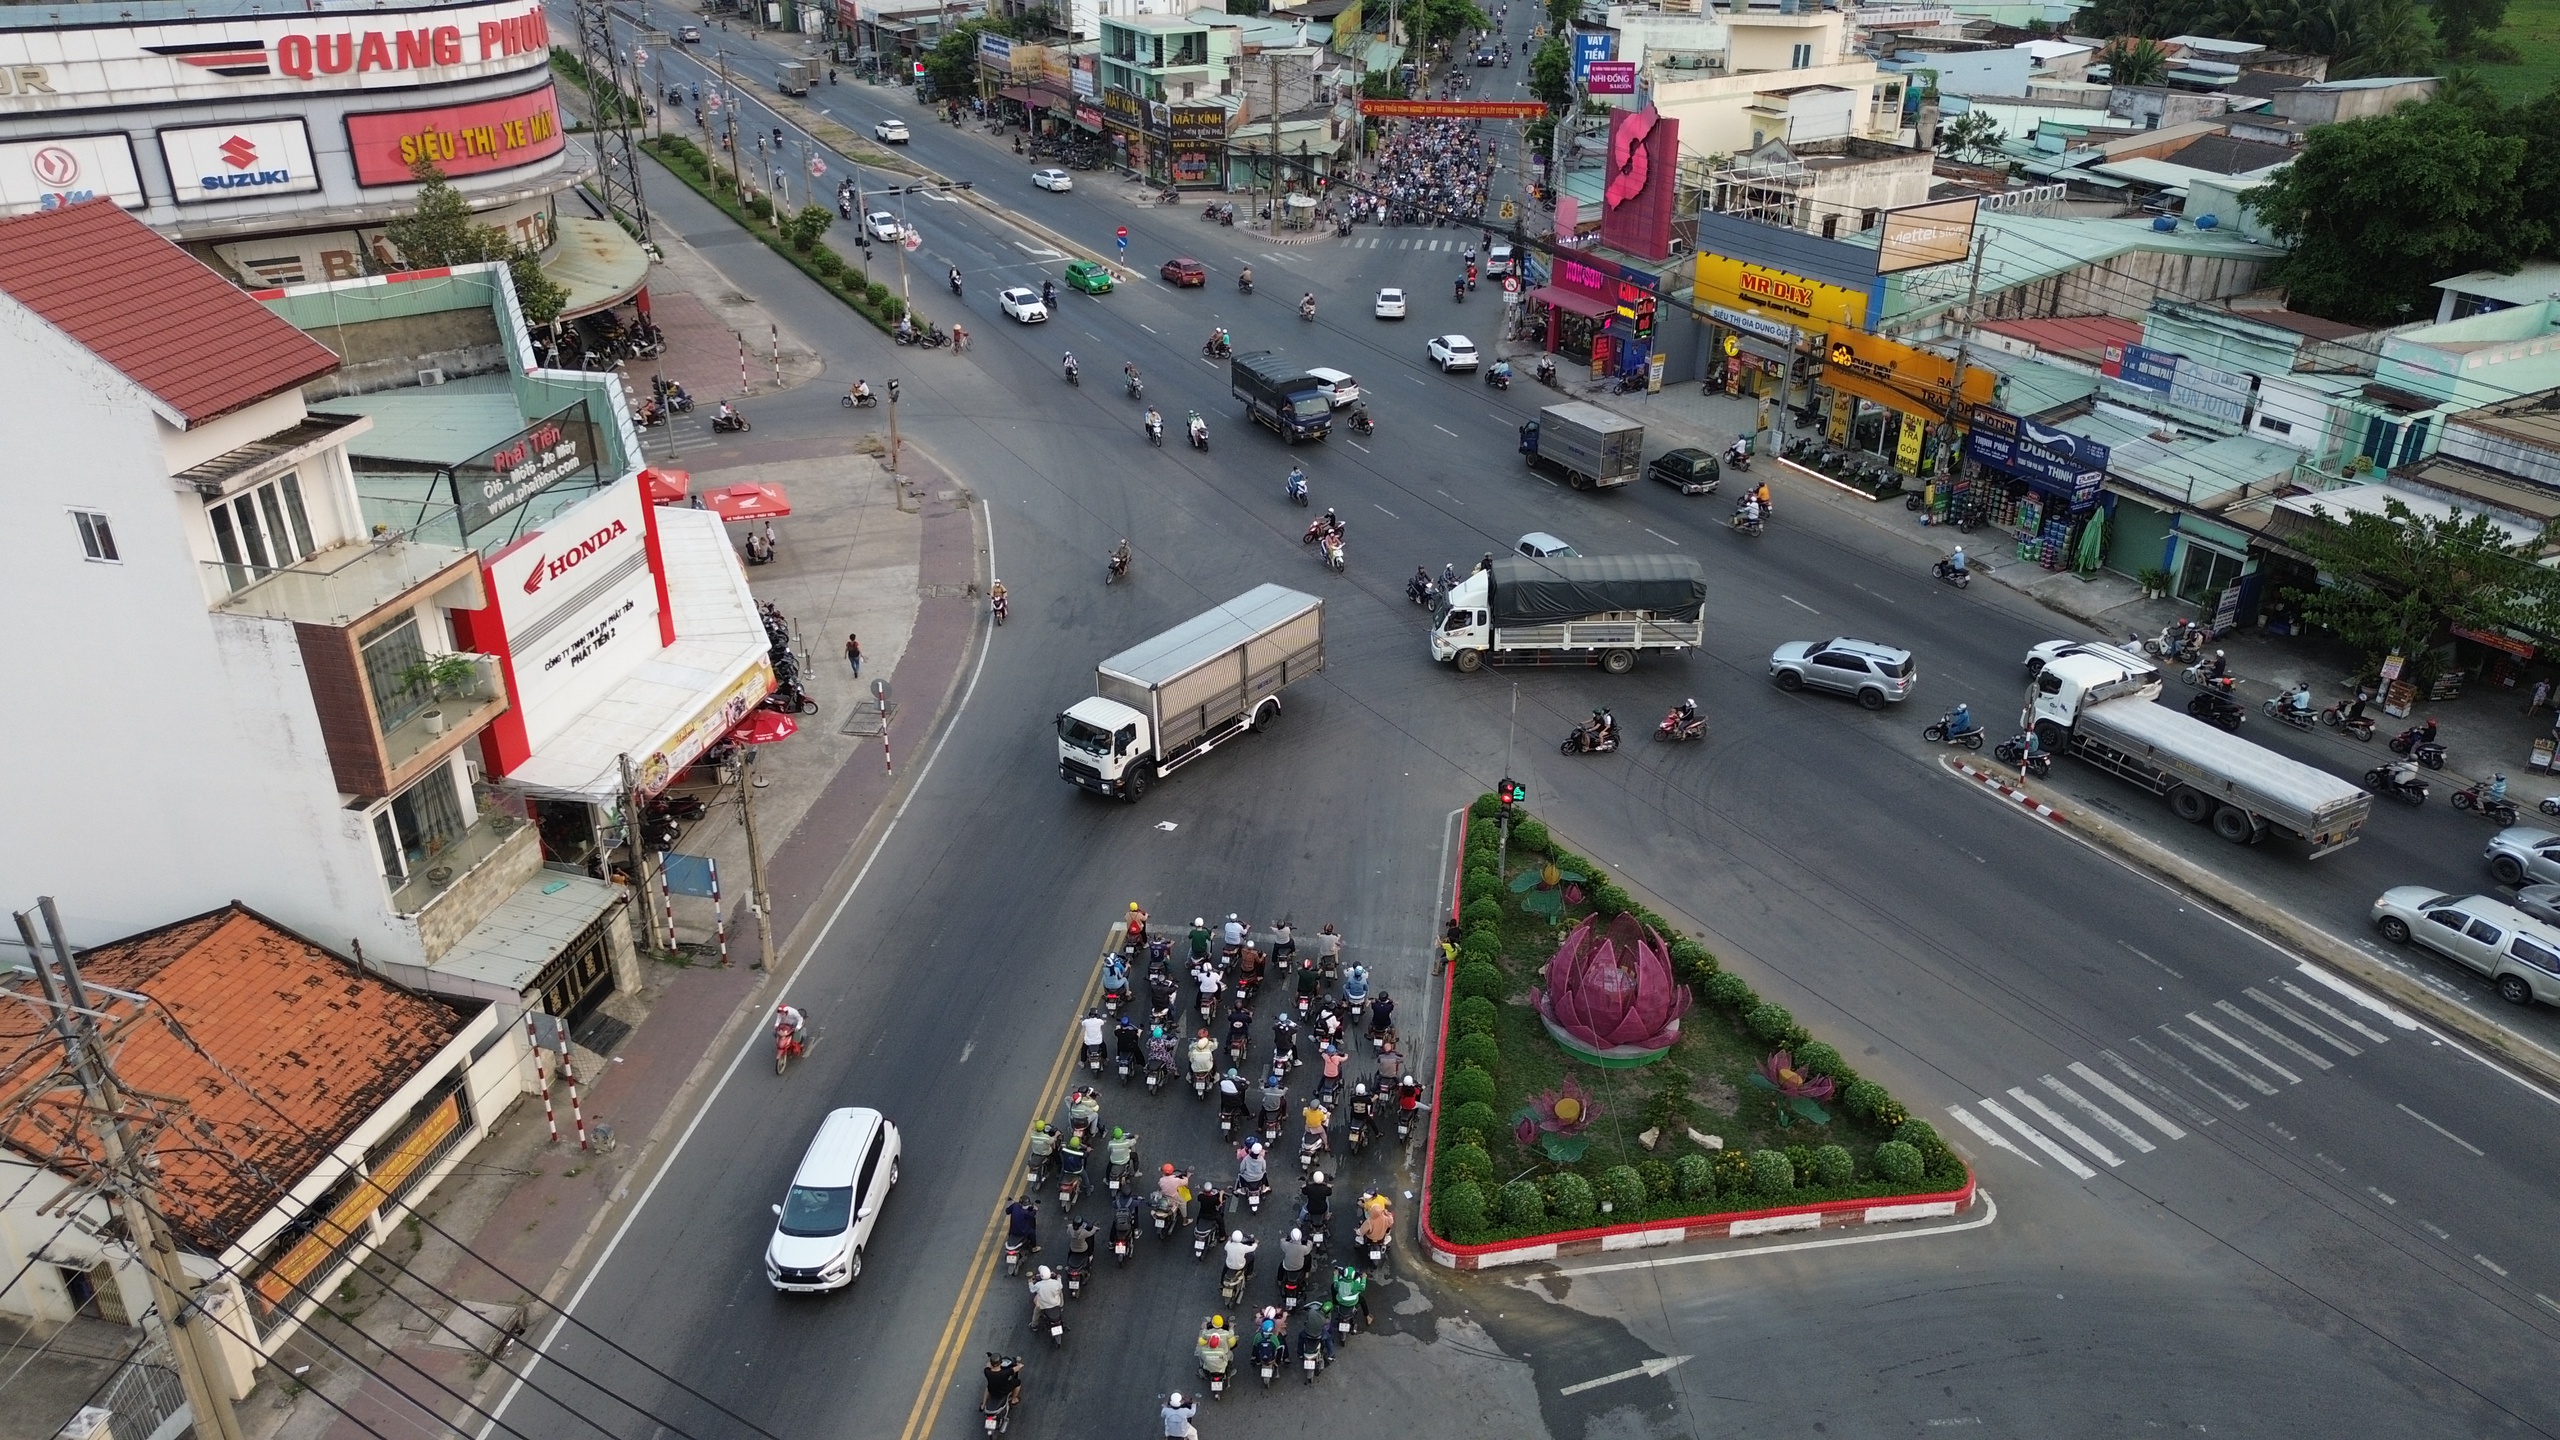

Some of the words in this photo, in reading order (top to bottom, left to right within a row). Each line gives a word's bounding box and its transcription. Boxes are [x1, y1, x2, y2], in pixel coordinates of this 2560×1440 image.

[1587, 36, 1604, 45] VAY
[278, 26, 462, 80] QUANG
[1591, 75, 1606, 83] NHI
[1173, 109, 1195, 124] MẮT
[1198, 111, 1221, 124] KÍNH
[461, 125, 498, 161] THỊ
[502, 120, 527, 149] XE
[201, 169, 290, 190] SUZUKI
[41, 189, 94, 211] SYM
[1740, 272, 1772, 295] MR
[1742, 318, 1755, 328] GIA
[2173, 386, 2199, 410] SƠN
[2202, 396, 2243, 420] JOTUN
[1903, 428, 1919, 442] TRẢ
[541, 451, 556, 468] Xe
[556, 440, 577, 460] Máy
[1900, 442, 1918, 456] GÓP
[2047, 464, 2074, 483] THỊNH
[487, 455, 581, 516] www.phattien.com
[547, 519, 627, 581] HONDA
[571, 644, 592, 668] PHÁT
[592, 628, 610, 651] TIẾN
[610, 627, 617, 638] 2
[1154, 950, 1159, 958] 9
